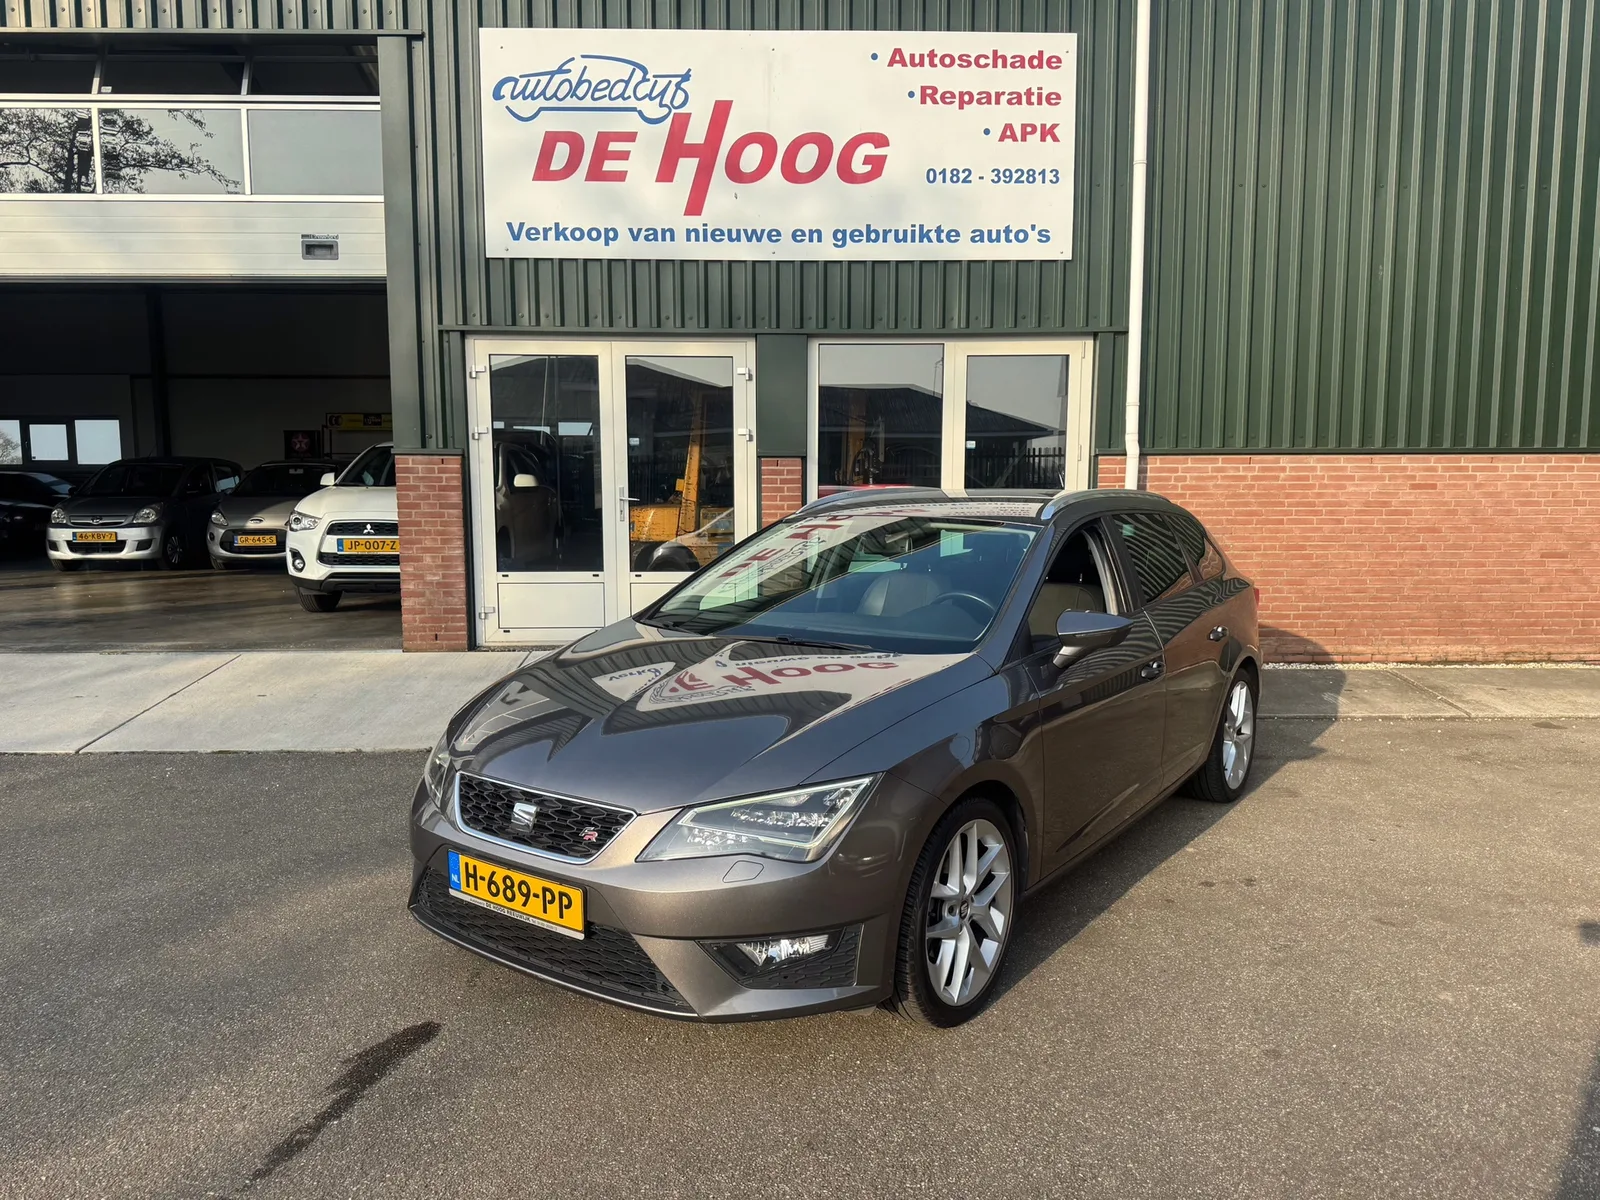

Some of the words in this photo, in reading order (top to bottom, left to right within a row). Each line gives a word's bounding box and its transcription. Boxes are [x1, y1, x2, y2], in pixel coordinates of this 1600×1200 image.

[887, 47, 1063, 70] Autoschade
[920, 85, 1062, 110] Reparatie
[998, 123, 1060, 143] APK
[532, 130, 638, 182] DE
[655, 100, 890, 216] HOOG
[926, 168, 973, 184] 0182
[990, 168, 1060, 184] 392813
[506, 222, 619, 246] Verkoop
[628, 226, 676, 243] van
[685, 222, 782, 243] nieuwe
[791, 226, 823, 244] en
[832, 224, 961, 249] gebruikte
[969, 224, 1051, 243] auto's
[239, 536, 274, 544] GR-645-S
[464, 861, 573, 919] H-689-PP
